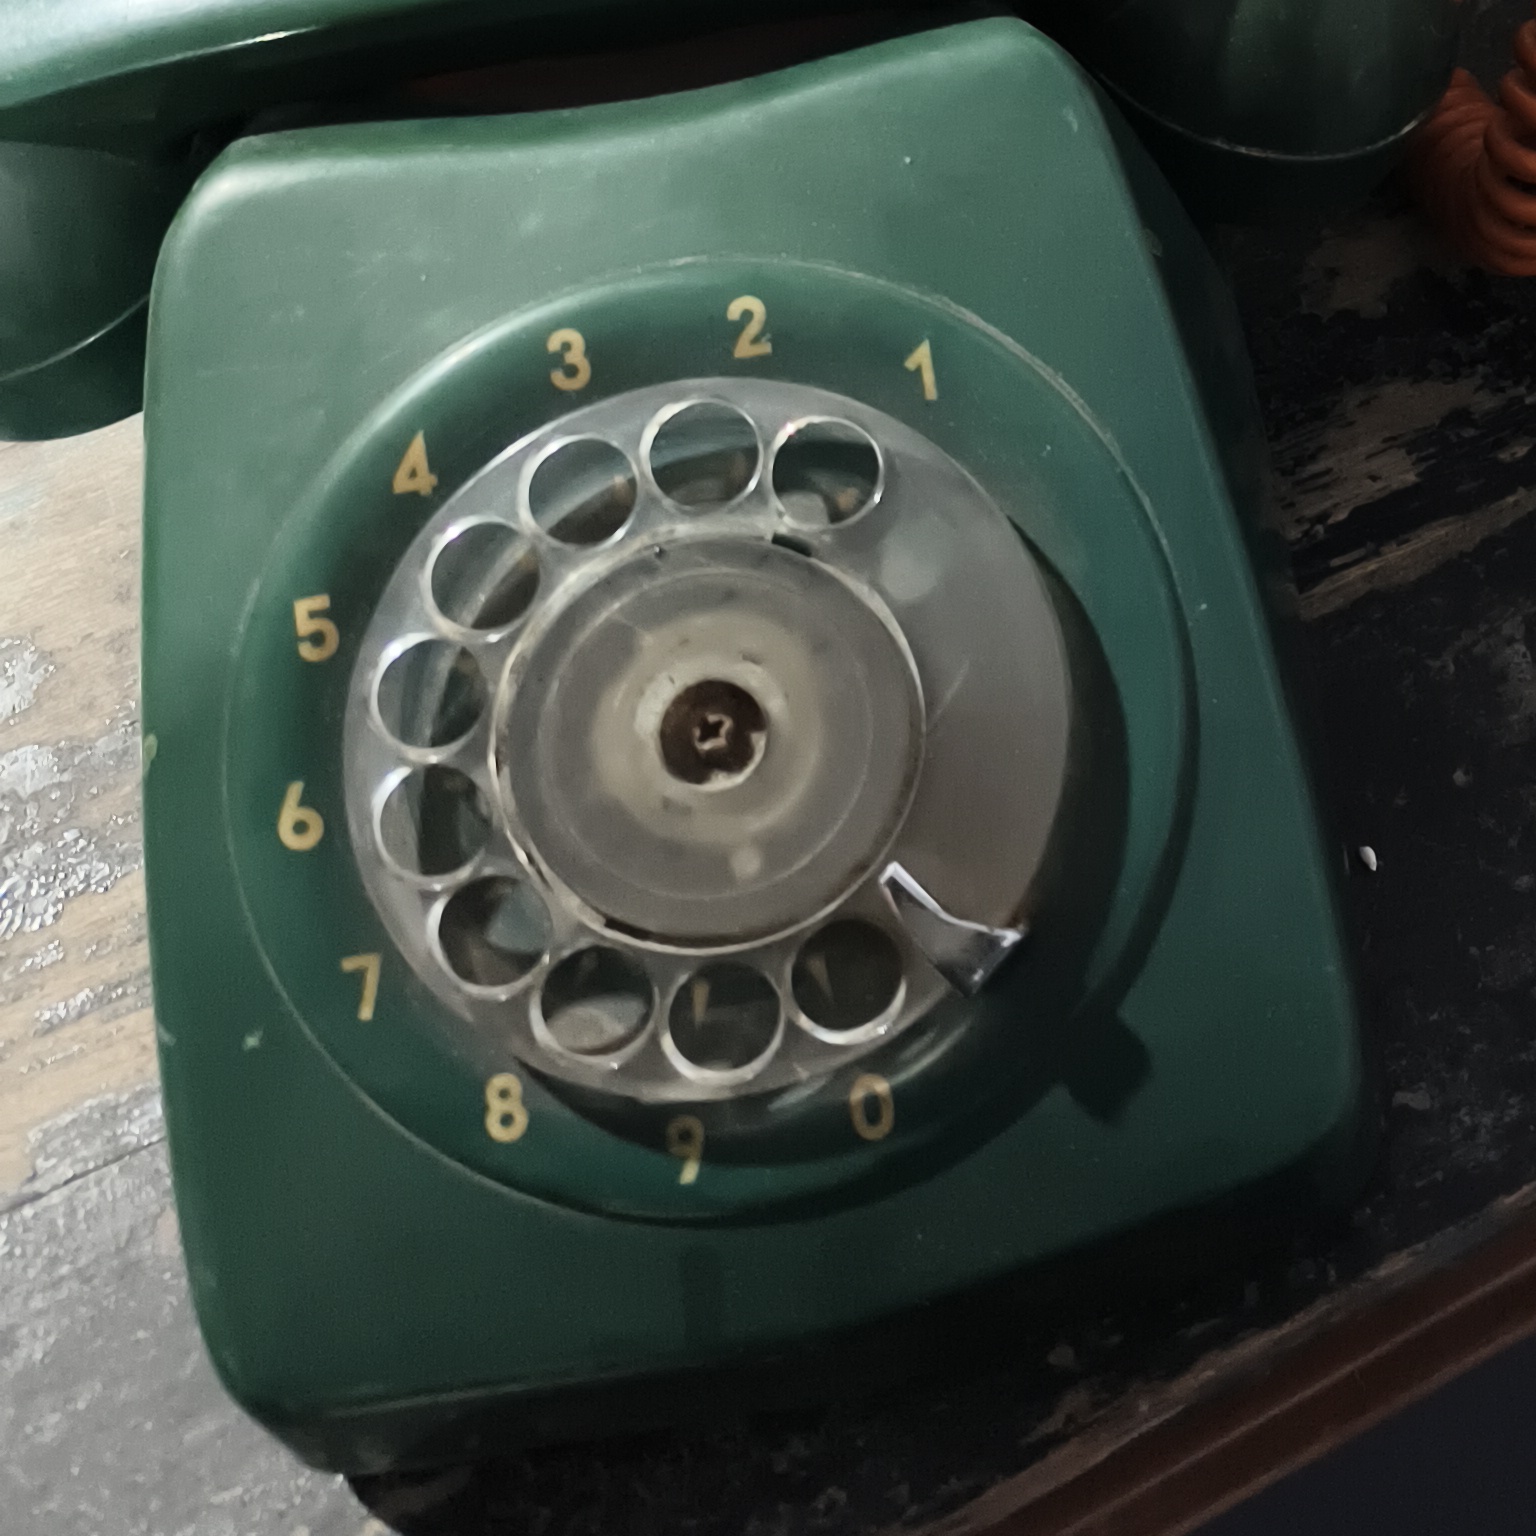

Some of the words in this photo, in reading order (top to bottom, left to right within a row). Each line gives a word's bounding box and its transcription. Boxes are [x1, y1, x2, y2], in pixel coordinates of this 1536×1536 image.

[547, 328, 591, 392] 3
[726, 296, 773, 360] 2
[904, 338, 941, 401] 1
[392, 430, 438, 497] 4
[294, 595, 339, 663] 5
[276, 783, 325, 850] 6
[341, 955, 382, 1021] 7
[483, 1073, 530, 1142] 8
[848, 1073, 896, 1140] 0
[664, 1116, 705, 1185] 9
